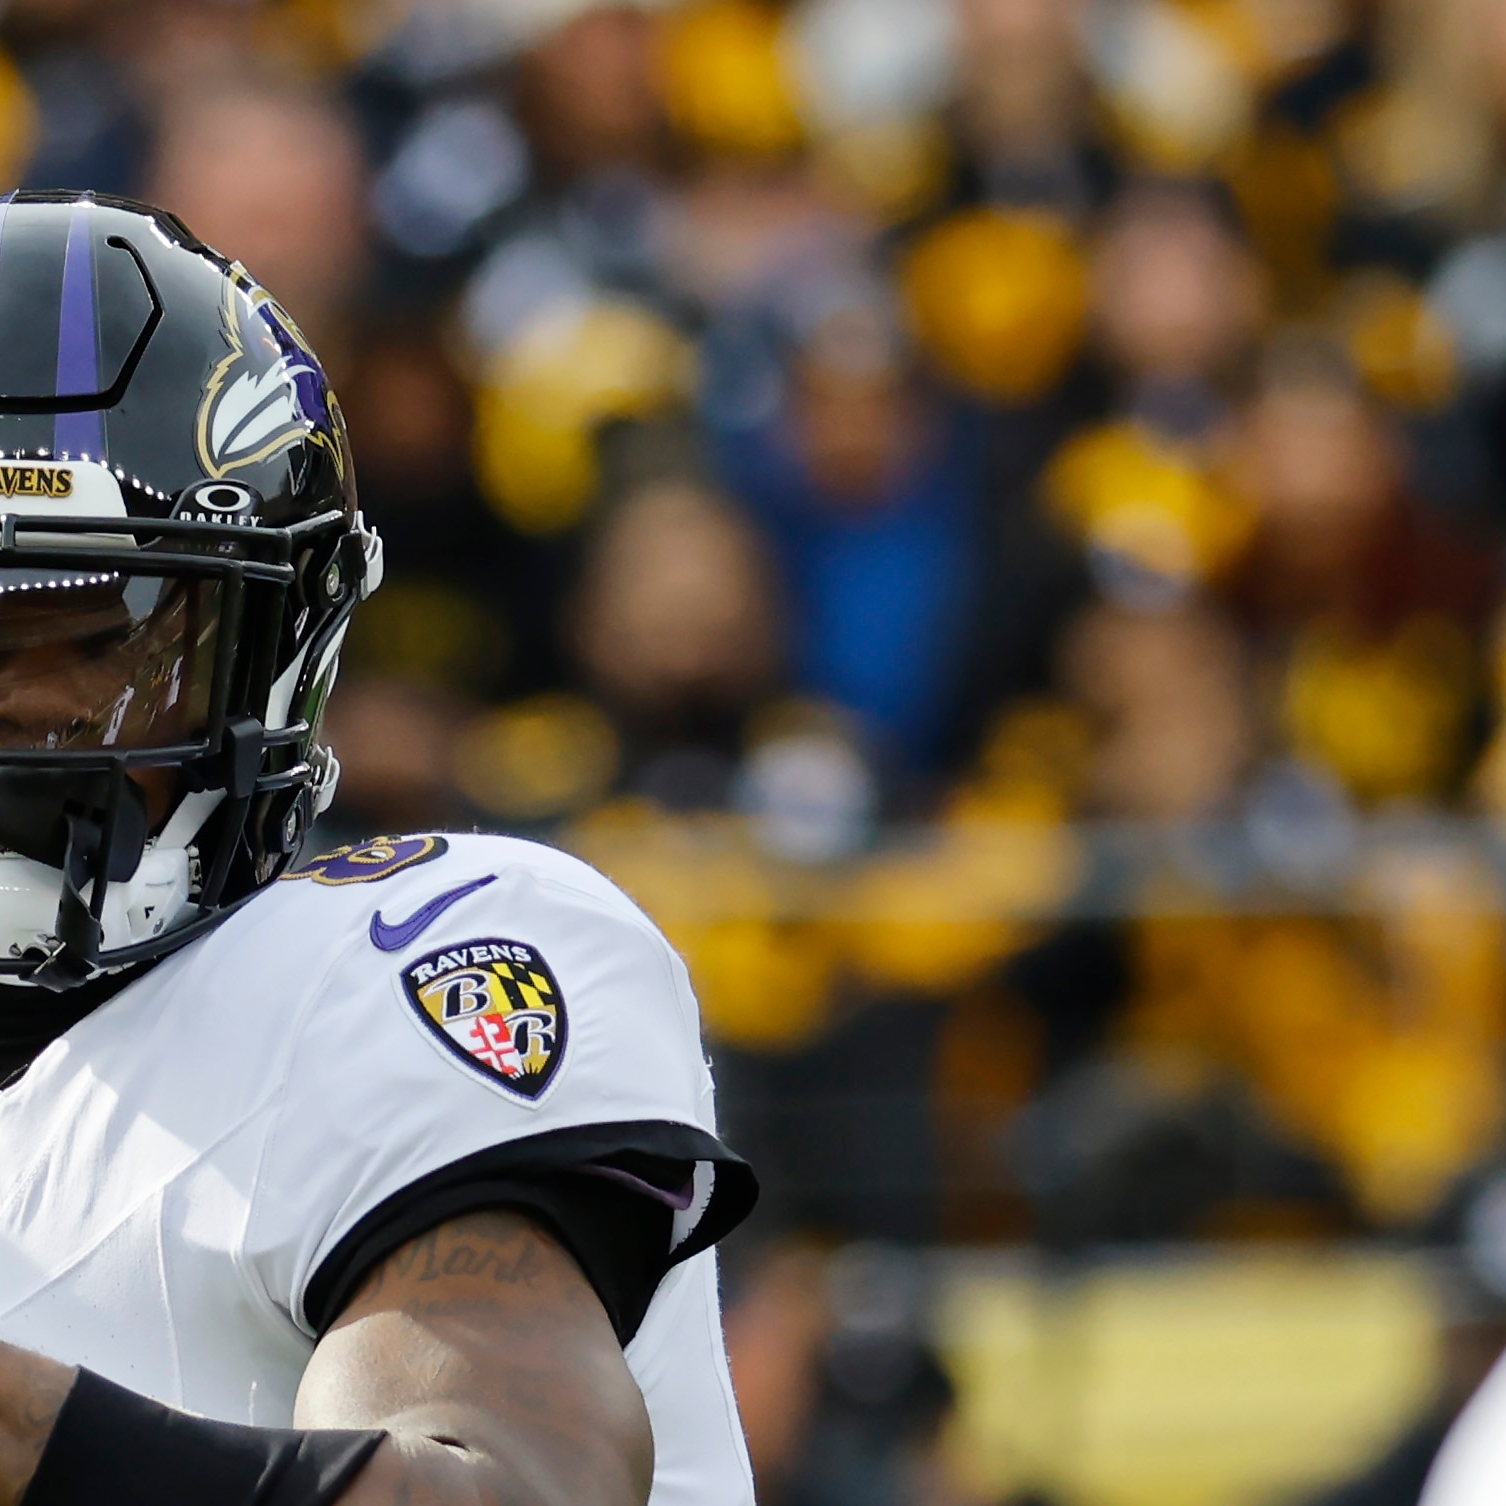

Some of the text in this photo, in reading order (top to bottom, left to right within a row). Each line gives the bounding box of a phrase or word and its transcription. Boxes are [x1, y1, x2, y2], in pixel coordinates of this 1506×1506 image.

[410, 944, 532, 985] RAVENS
[423, 970, 491, 1021] B
[505, 1010, 556, 1057] R
